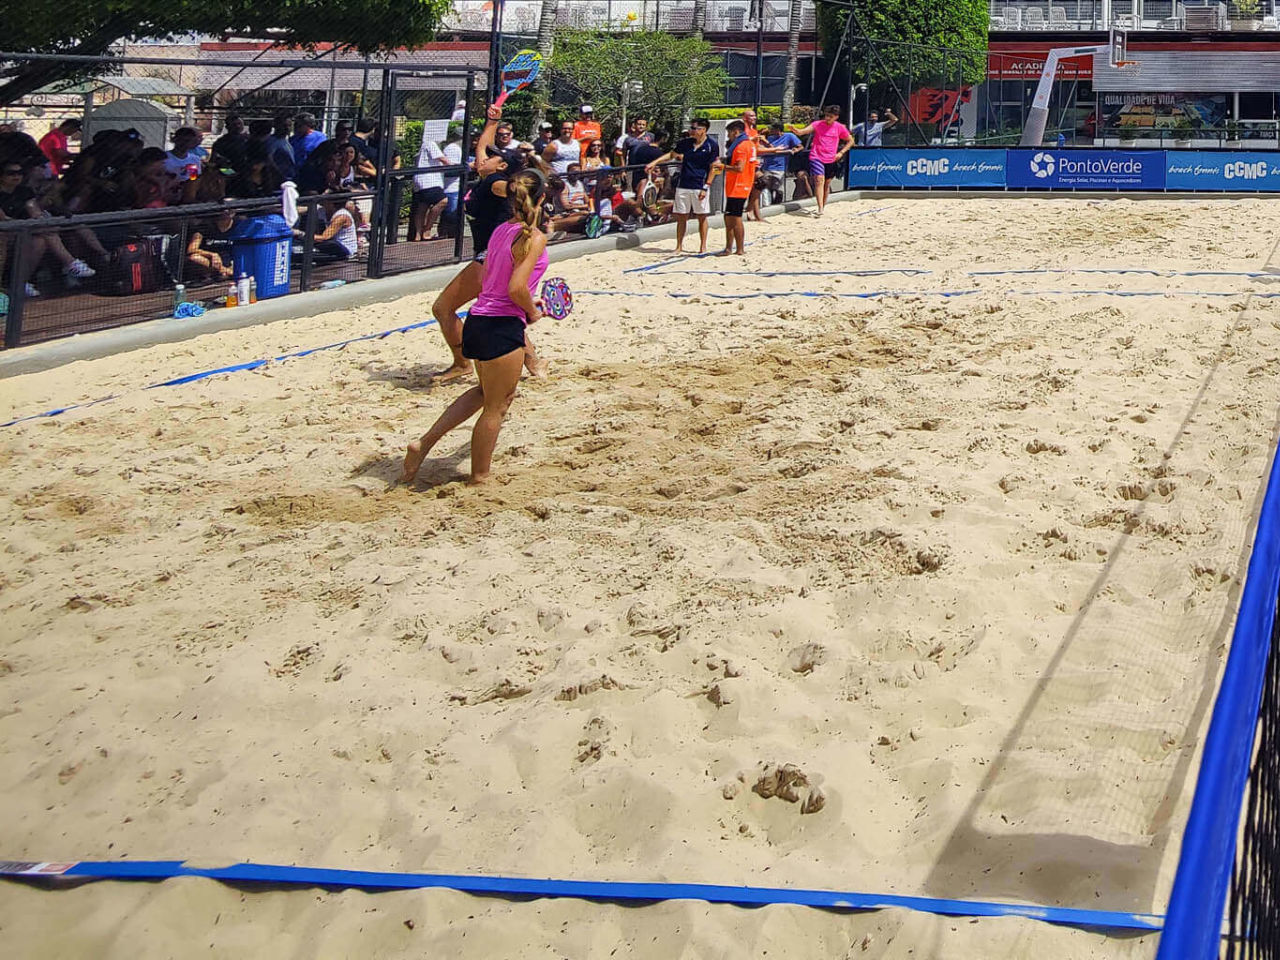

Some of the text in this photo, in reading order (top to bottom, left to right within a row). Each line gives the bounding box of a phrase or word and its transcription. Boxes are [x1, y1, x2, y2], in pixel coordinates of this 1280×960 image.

[906, 157, 950, 176] CCMC
[1059, 158, 1142, 174] PontoVerde
[1224, 161, 1267, 180] CCMC
